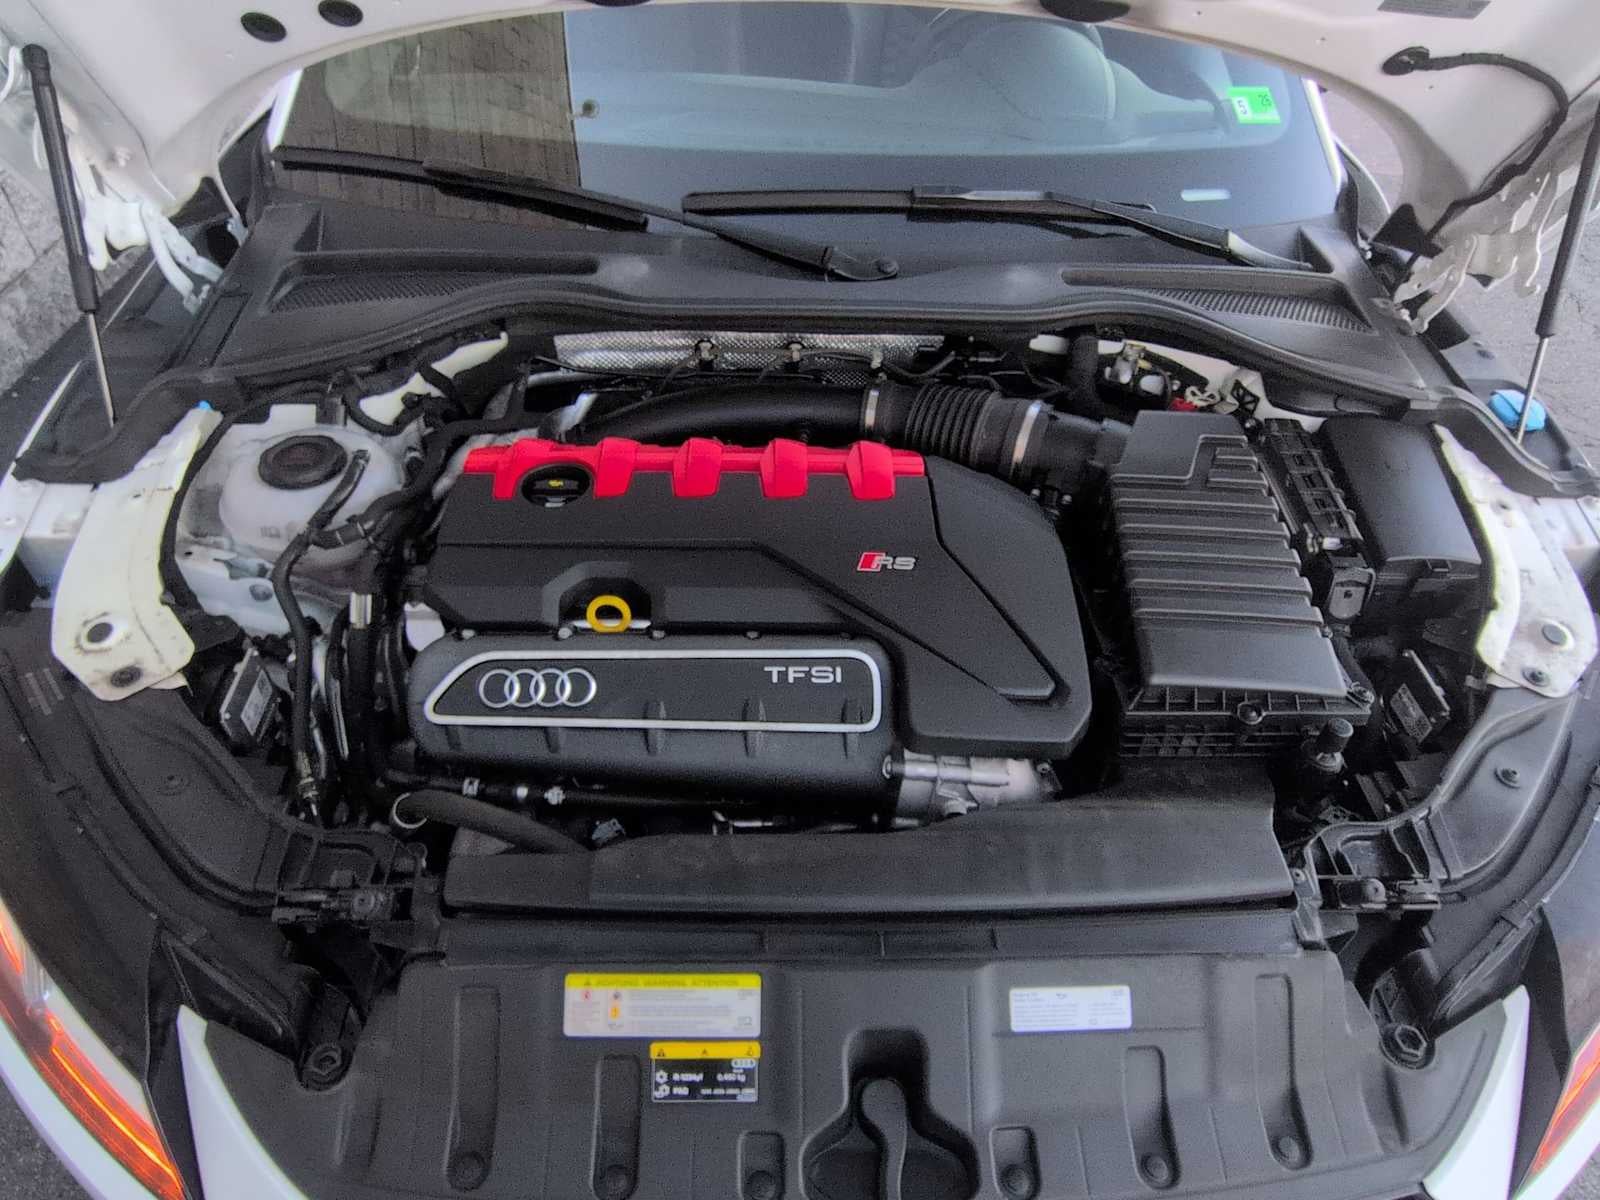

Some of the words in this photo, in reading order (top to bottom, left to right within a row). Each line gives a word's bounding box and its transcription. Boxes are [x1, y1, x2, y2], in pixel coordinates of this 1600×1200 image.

[1237, 100, 1248, 115] 5
[869, 554, 916, 571] RS
[763, 665, 843, 684] TFSI
